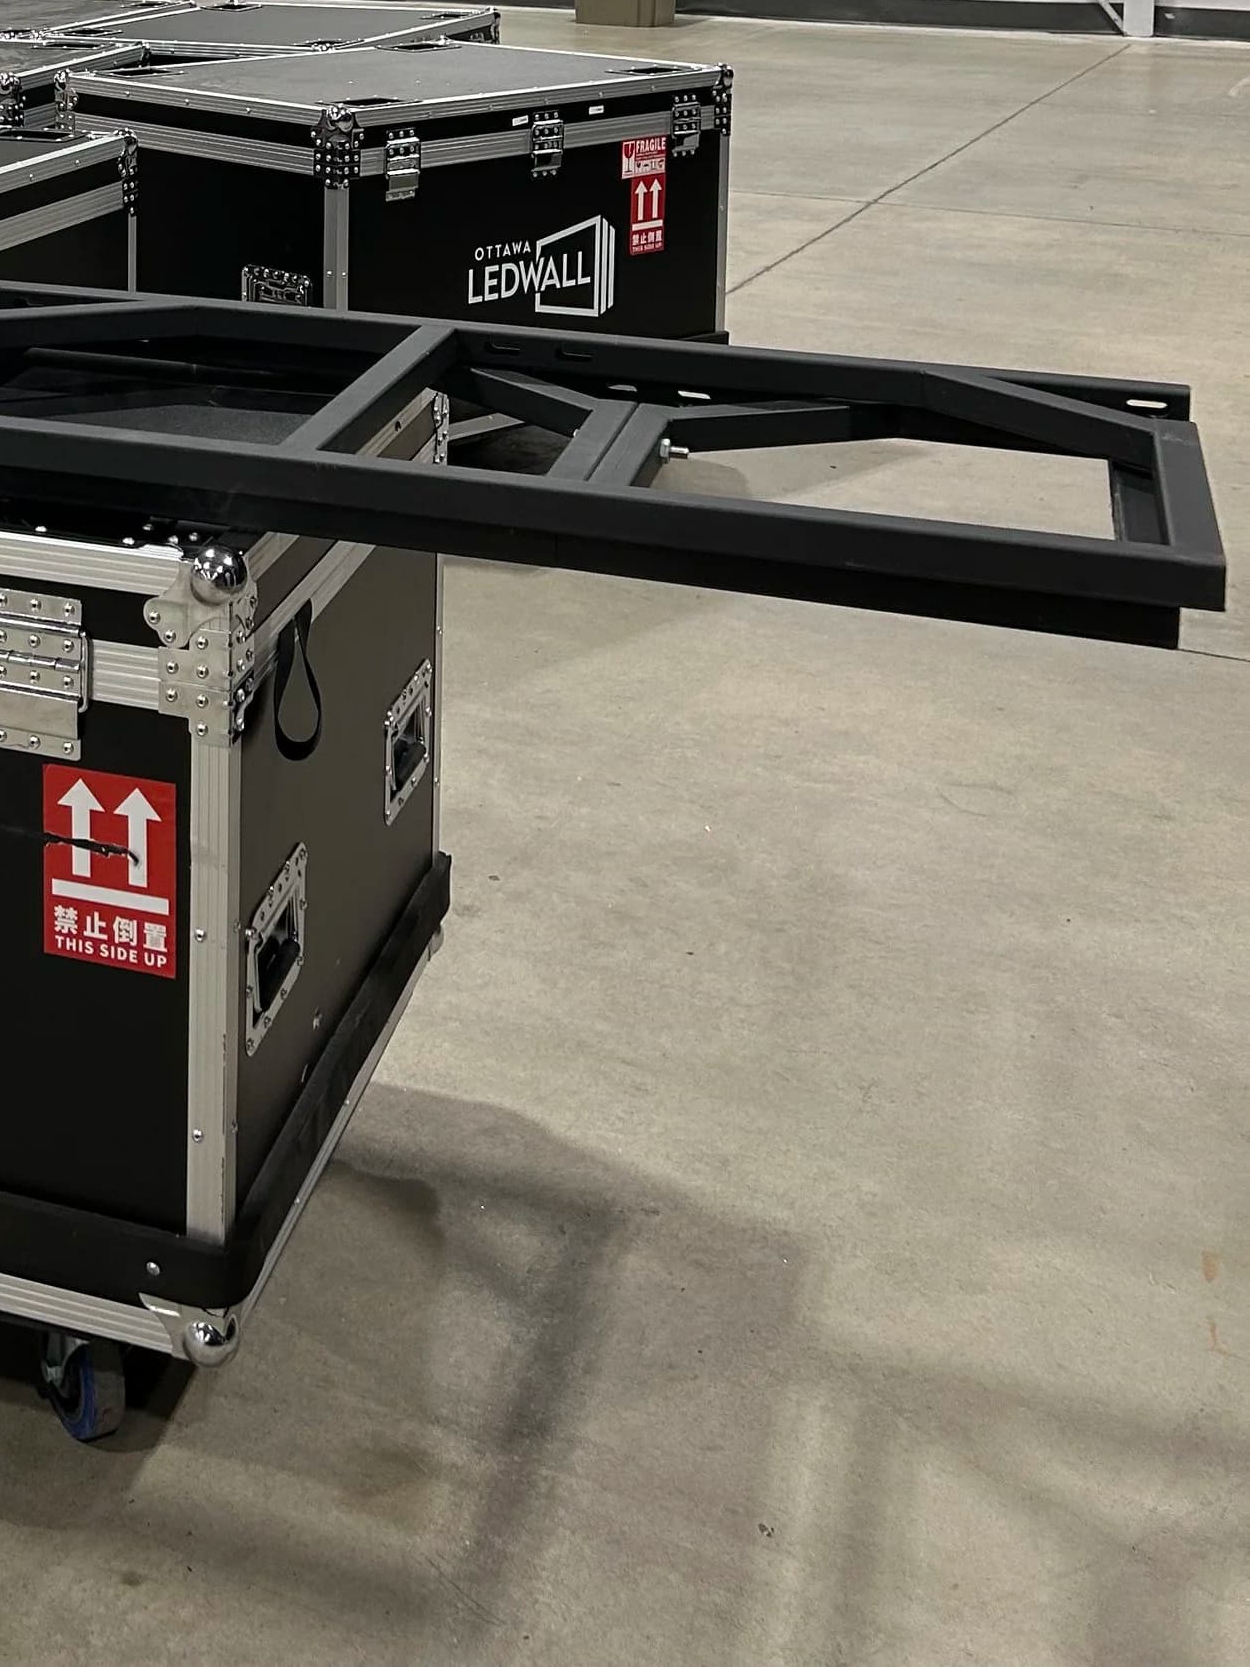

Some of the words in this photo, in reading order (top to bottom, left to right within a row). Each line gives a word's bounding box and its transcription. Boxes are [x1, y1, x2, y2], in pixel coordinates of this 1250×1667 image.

[636, 137, 667, 154] FRAGILE
[474, 240, 531, 261] OTTAWA
[468, 251, 591, 304] LEDWALL
[54, 904, 168, 953] 禁止倒置
[55, 934, 95, 955] THIS
[99, 943, 138, 964] SIDE
[144, 952, 167, 968] UP
